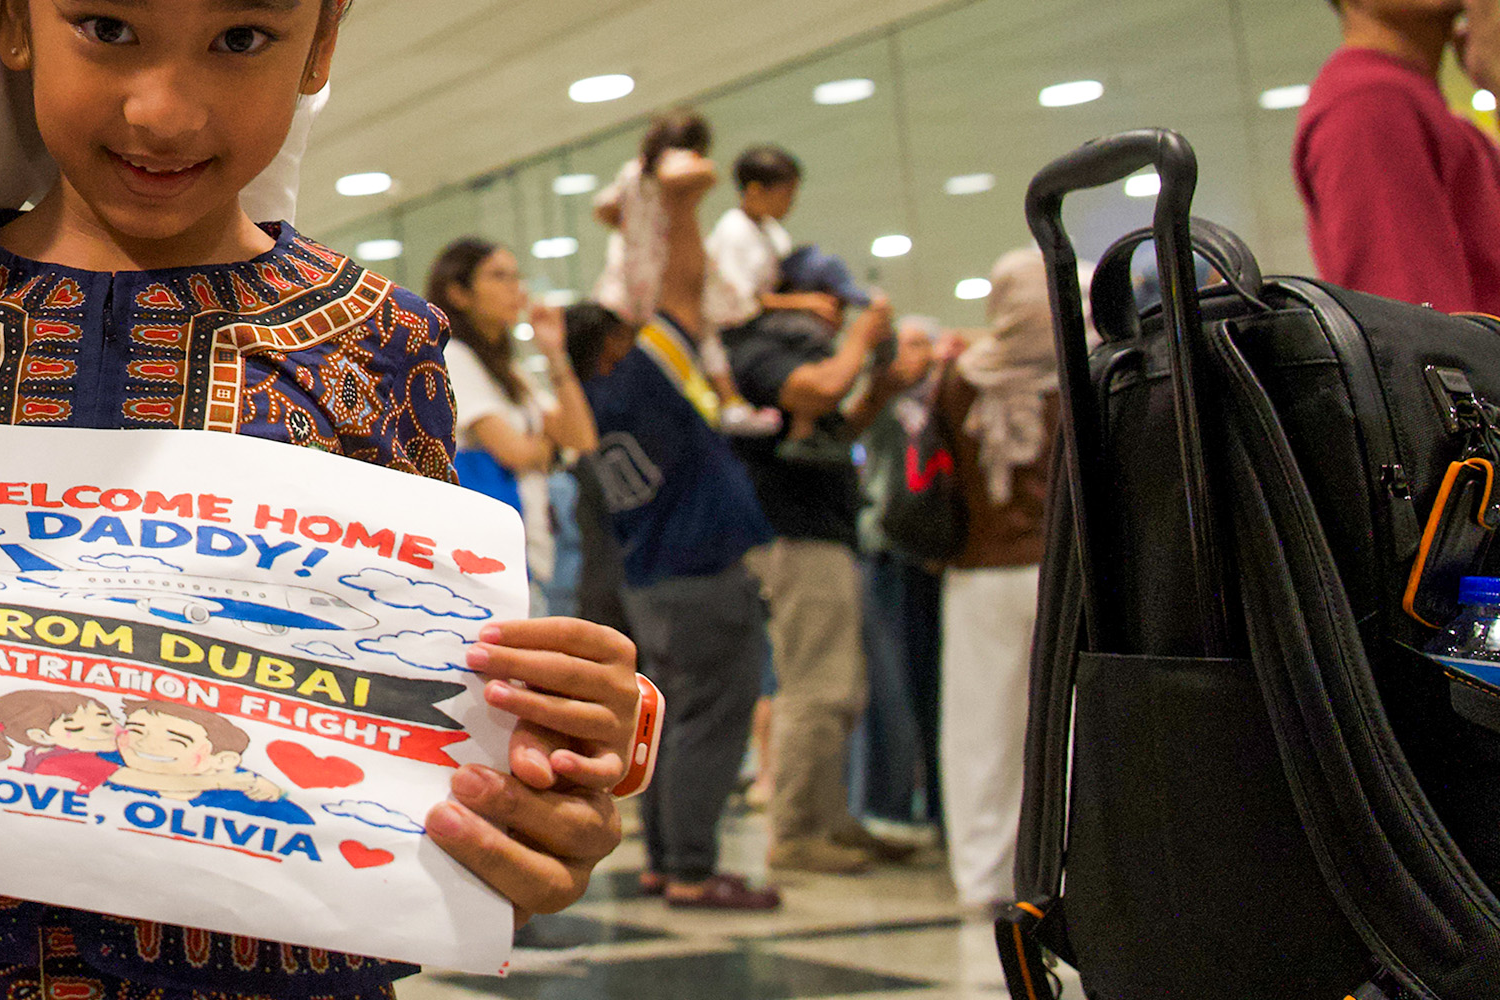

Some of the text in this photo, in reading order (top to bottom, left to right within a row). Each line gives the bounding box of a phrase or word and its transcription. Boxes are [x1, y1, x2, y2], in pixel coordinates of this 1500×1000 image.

[26, 510, 330, 578] DADDY!
[255, 503, 437, 570] HOME
[160, 632, 371, 707] DUBAI
[240, 694, 412, 751] FLIGHT
[124, 800, 322, 862] OLIVIA
